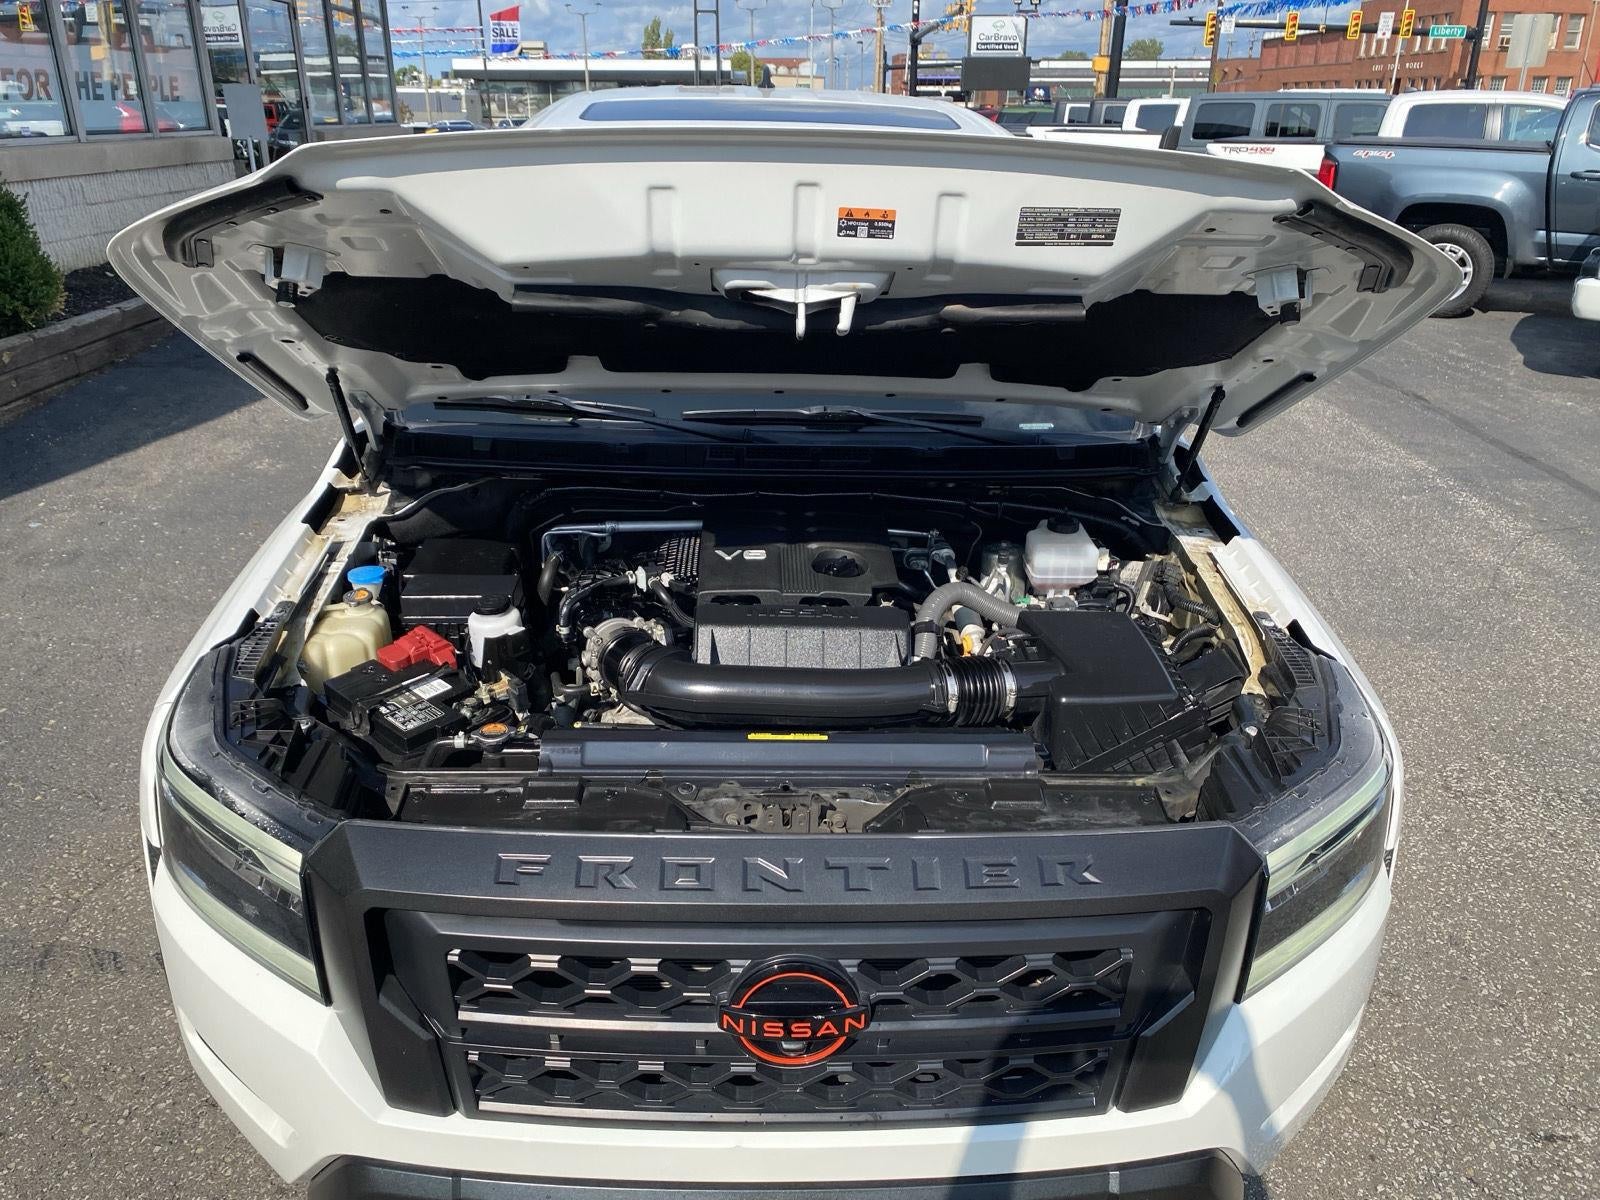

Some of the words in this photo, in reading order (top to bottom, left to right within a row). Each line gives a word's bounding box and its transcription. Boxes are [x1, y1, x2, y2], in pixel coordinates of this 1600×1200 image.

[492, 27, 518, 38] SALE
[978, 32, 1018, 41] CarBravo
[1434, 26, 1462, 37] Liberty
[0, 68, 52, 101] FOR
[715, 550, 767, 560] V6
[494, 853, 1103, 892] FRONTIER
[722, 1013, 866, 1039] NISSAN
